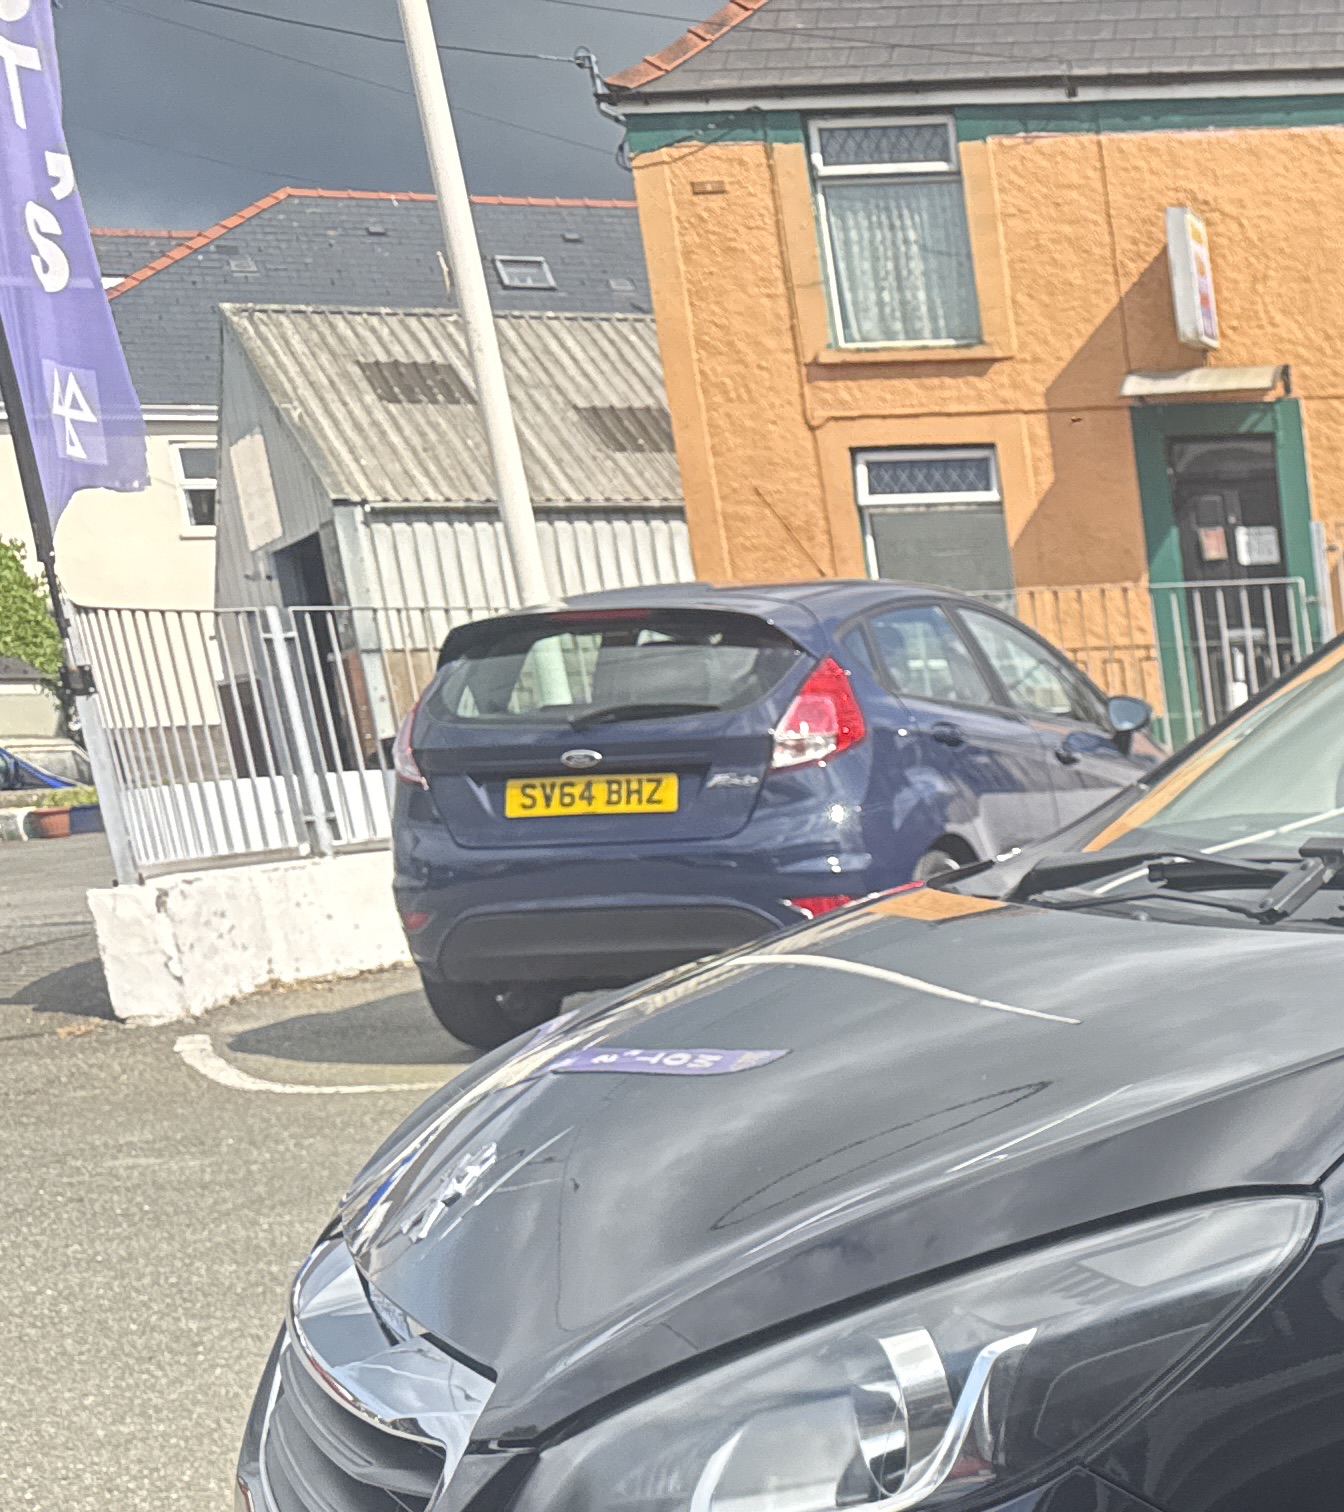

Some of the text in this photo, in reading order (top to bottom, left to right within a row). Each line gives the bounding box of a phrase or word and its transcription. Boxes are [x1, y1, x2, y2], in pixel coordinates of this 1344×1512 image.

[0, 0, 75, 292] T'S
[520, 777, 663, 810] SV64 BHZ
